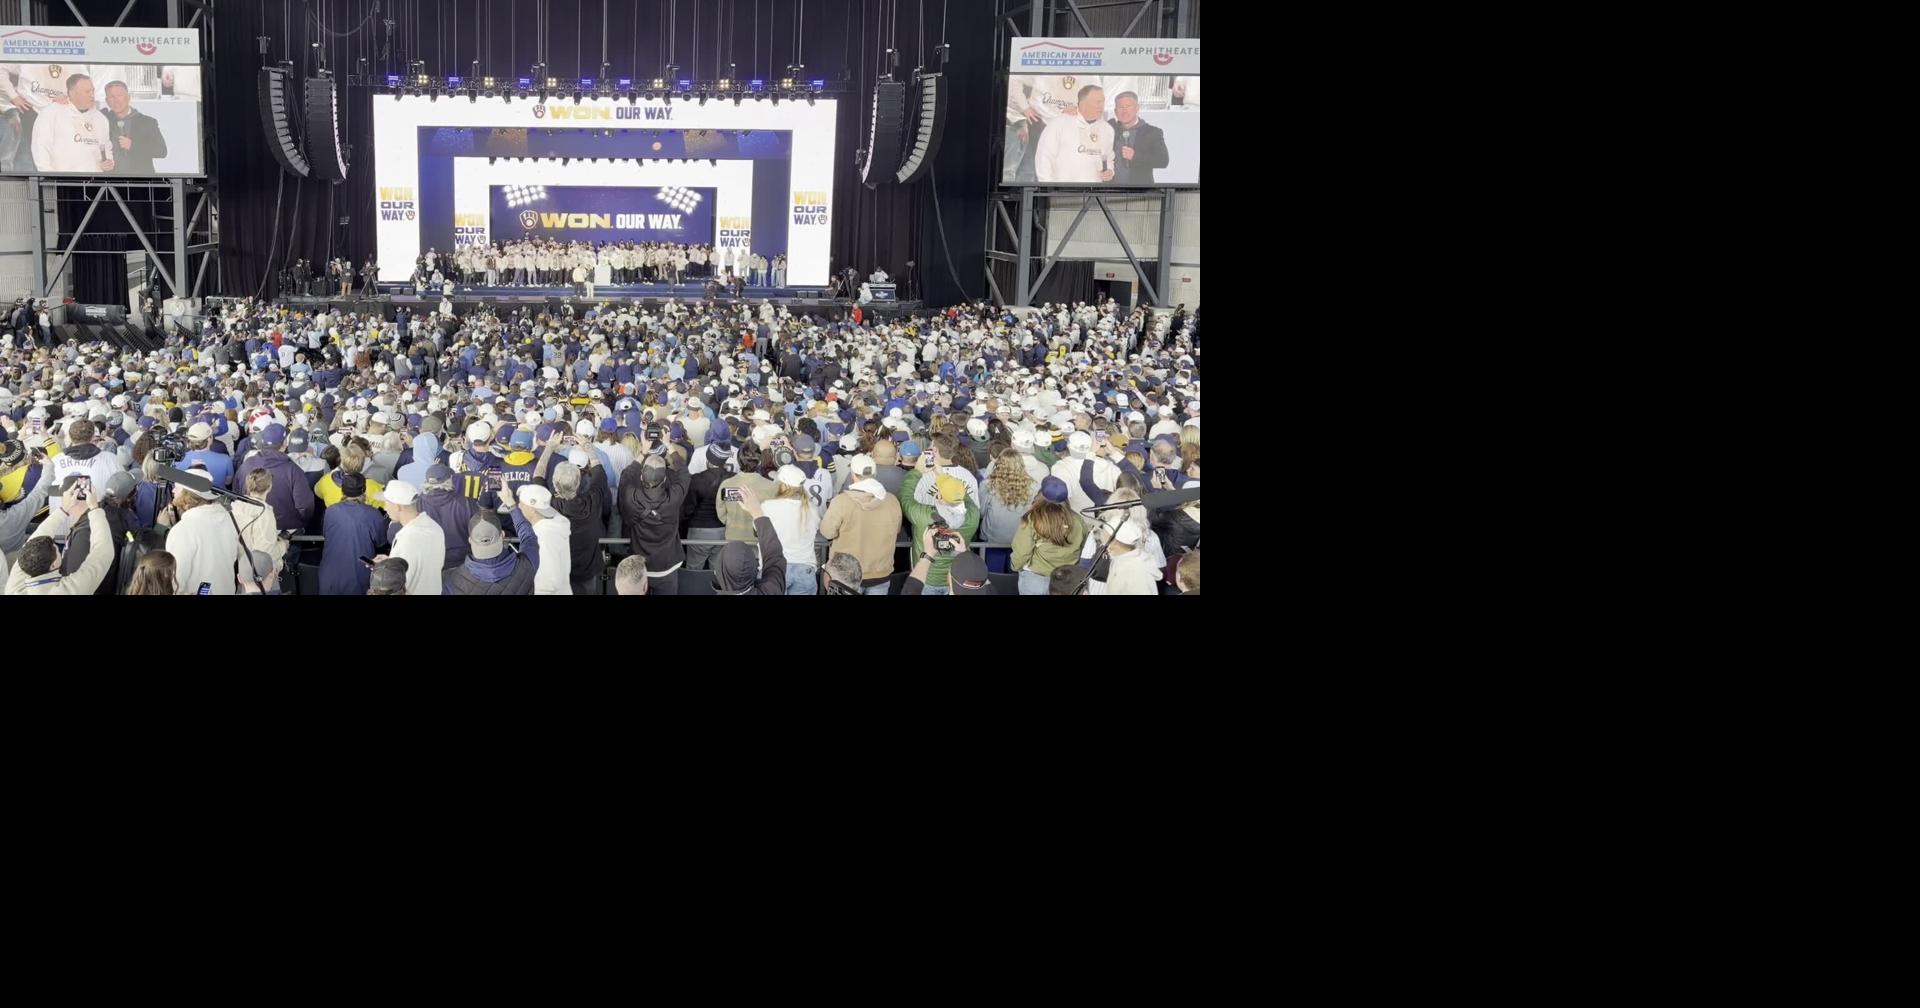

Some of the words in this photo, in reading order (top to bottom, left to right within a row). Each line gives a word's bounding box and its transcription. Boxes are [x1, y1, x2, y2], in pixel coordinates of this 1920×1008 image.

[3, 39, 49, 47] AMERICAN
[52, 40, 85, 48] FAMILY
[102, 36, 191, 45] AMPHITHEATER
[1120, 47, 1200, 56] AMPHITHEATE
[616, 107, 641, 120] OUR
[380, 201, 414, 209] OUR
[616, 213, 645, 229] OUR
[60, 457, 96, 469] BRAUN
[502, 471, 531, 482] ELICH
[464, 475, 481, 499] 11
